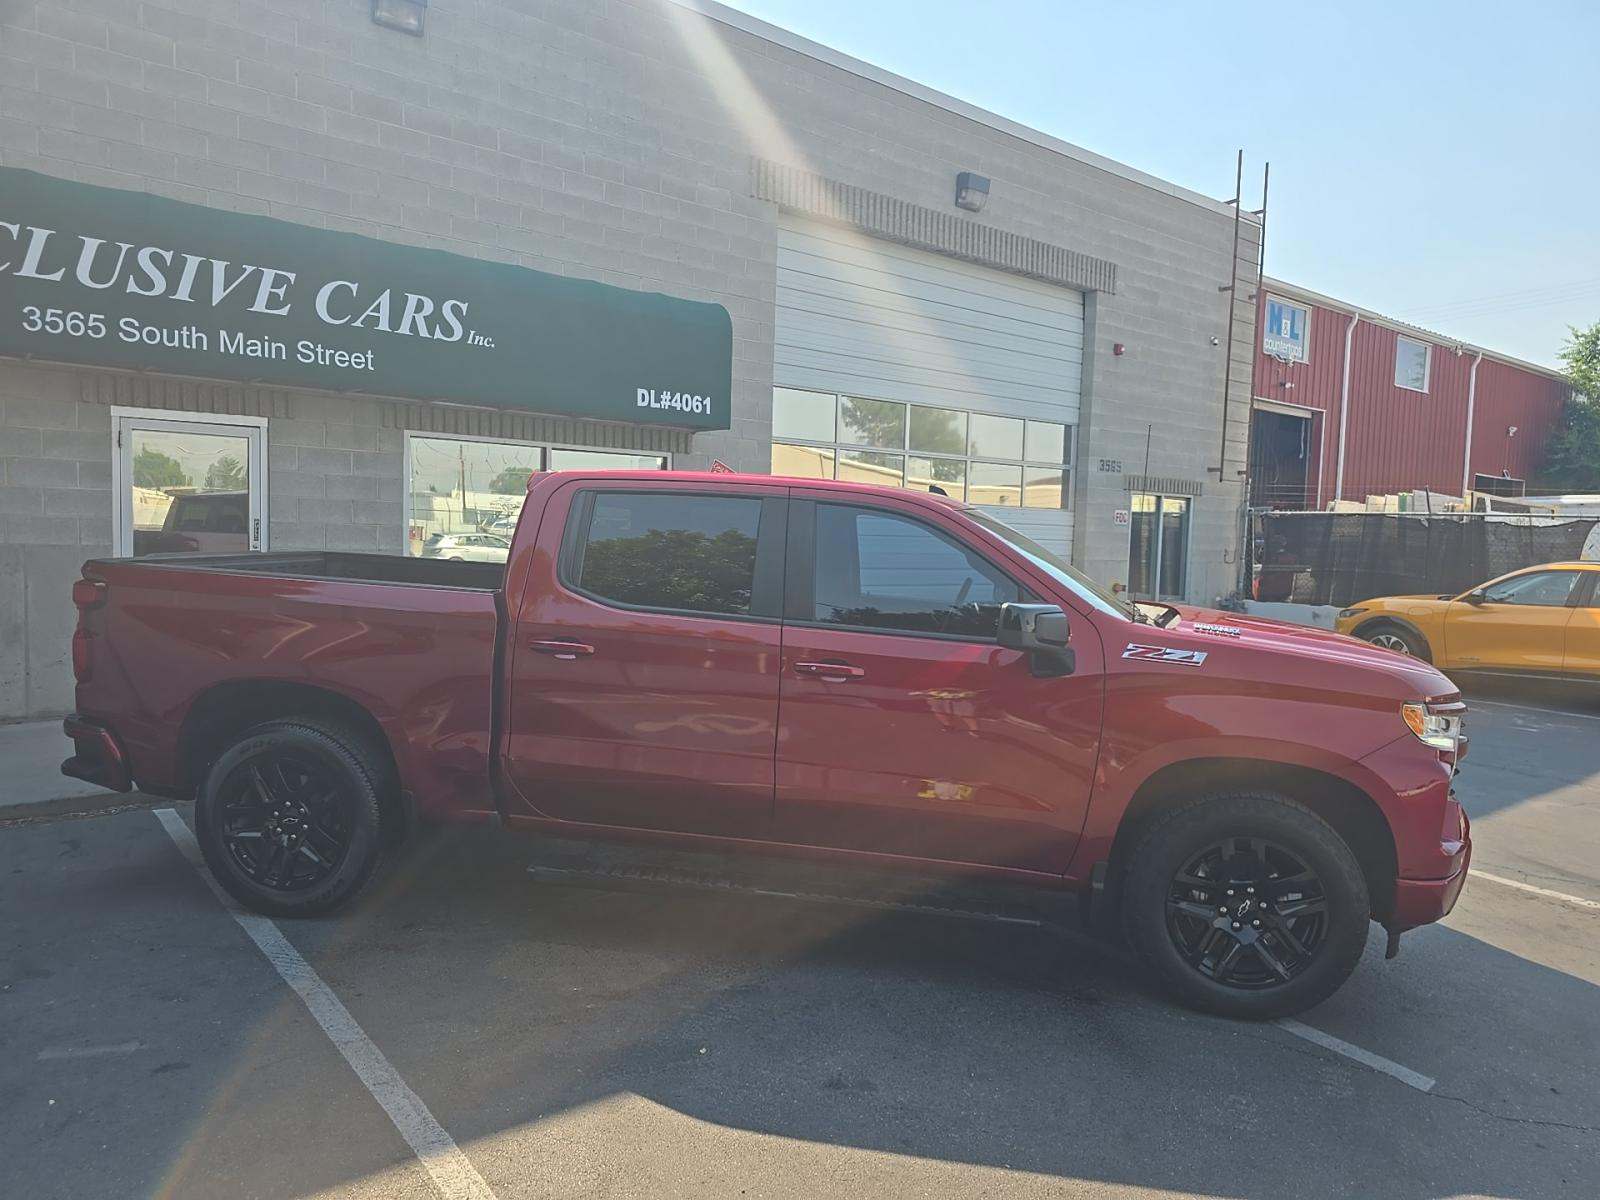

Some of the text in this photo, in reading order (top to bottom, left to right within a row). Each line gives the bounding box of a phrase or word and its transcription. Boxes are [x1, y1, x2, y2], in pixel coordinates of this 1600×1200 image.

[315, 280, 469, 344] CARS
[466, 329, 496, 348] Inc.
[22, 305, 375, 371] 3565 South Main Street
[636, 387, 711, 415] DL#4061
[1121, 642, 1208, 667] Z71
